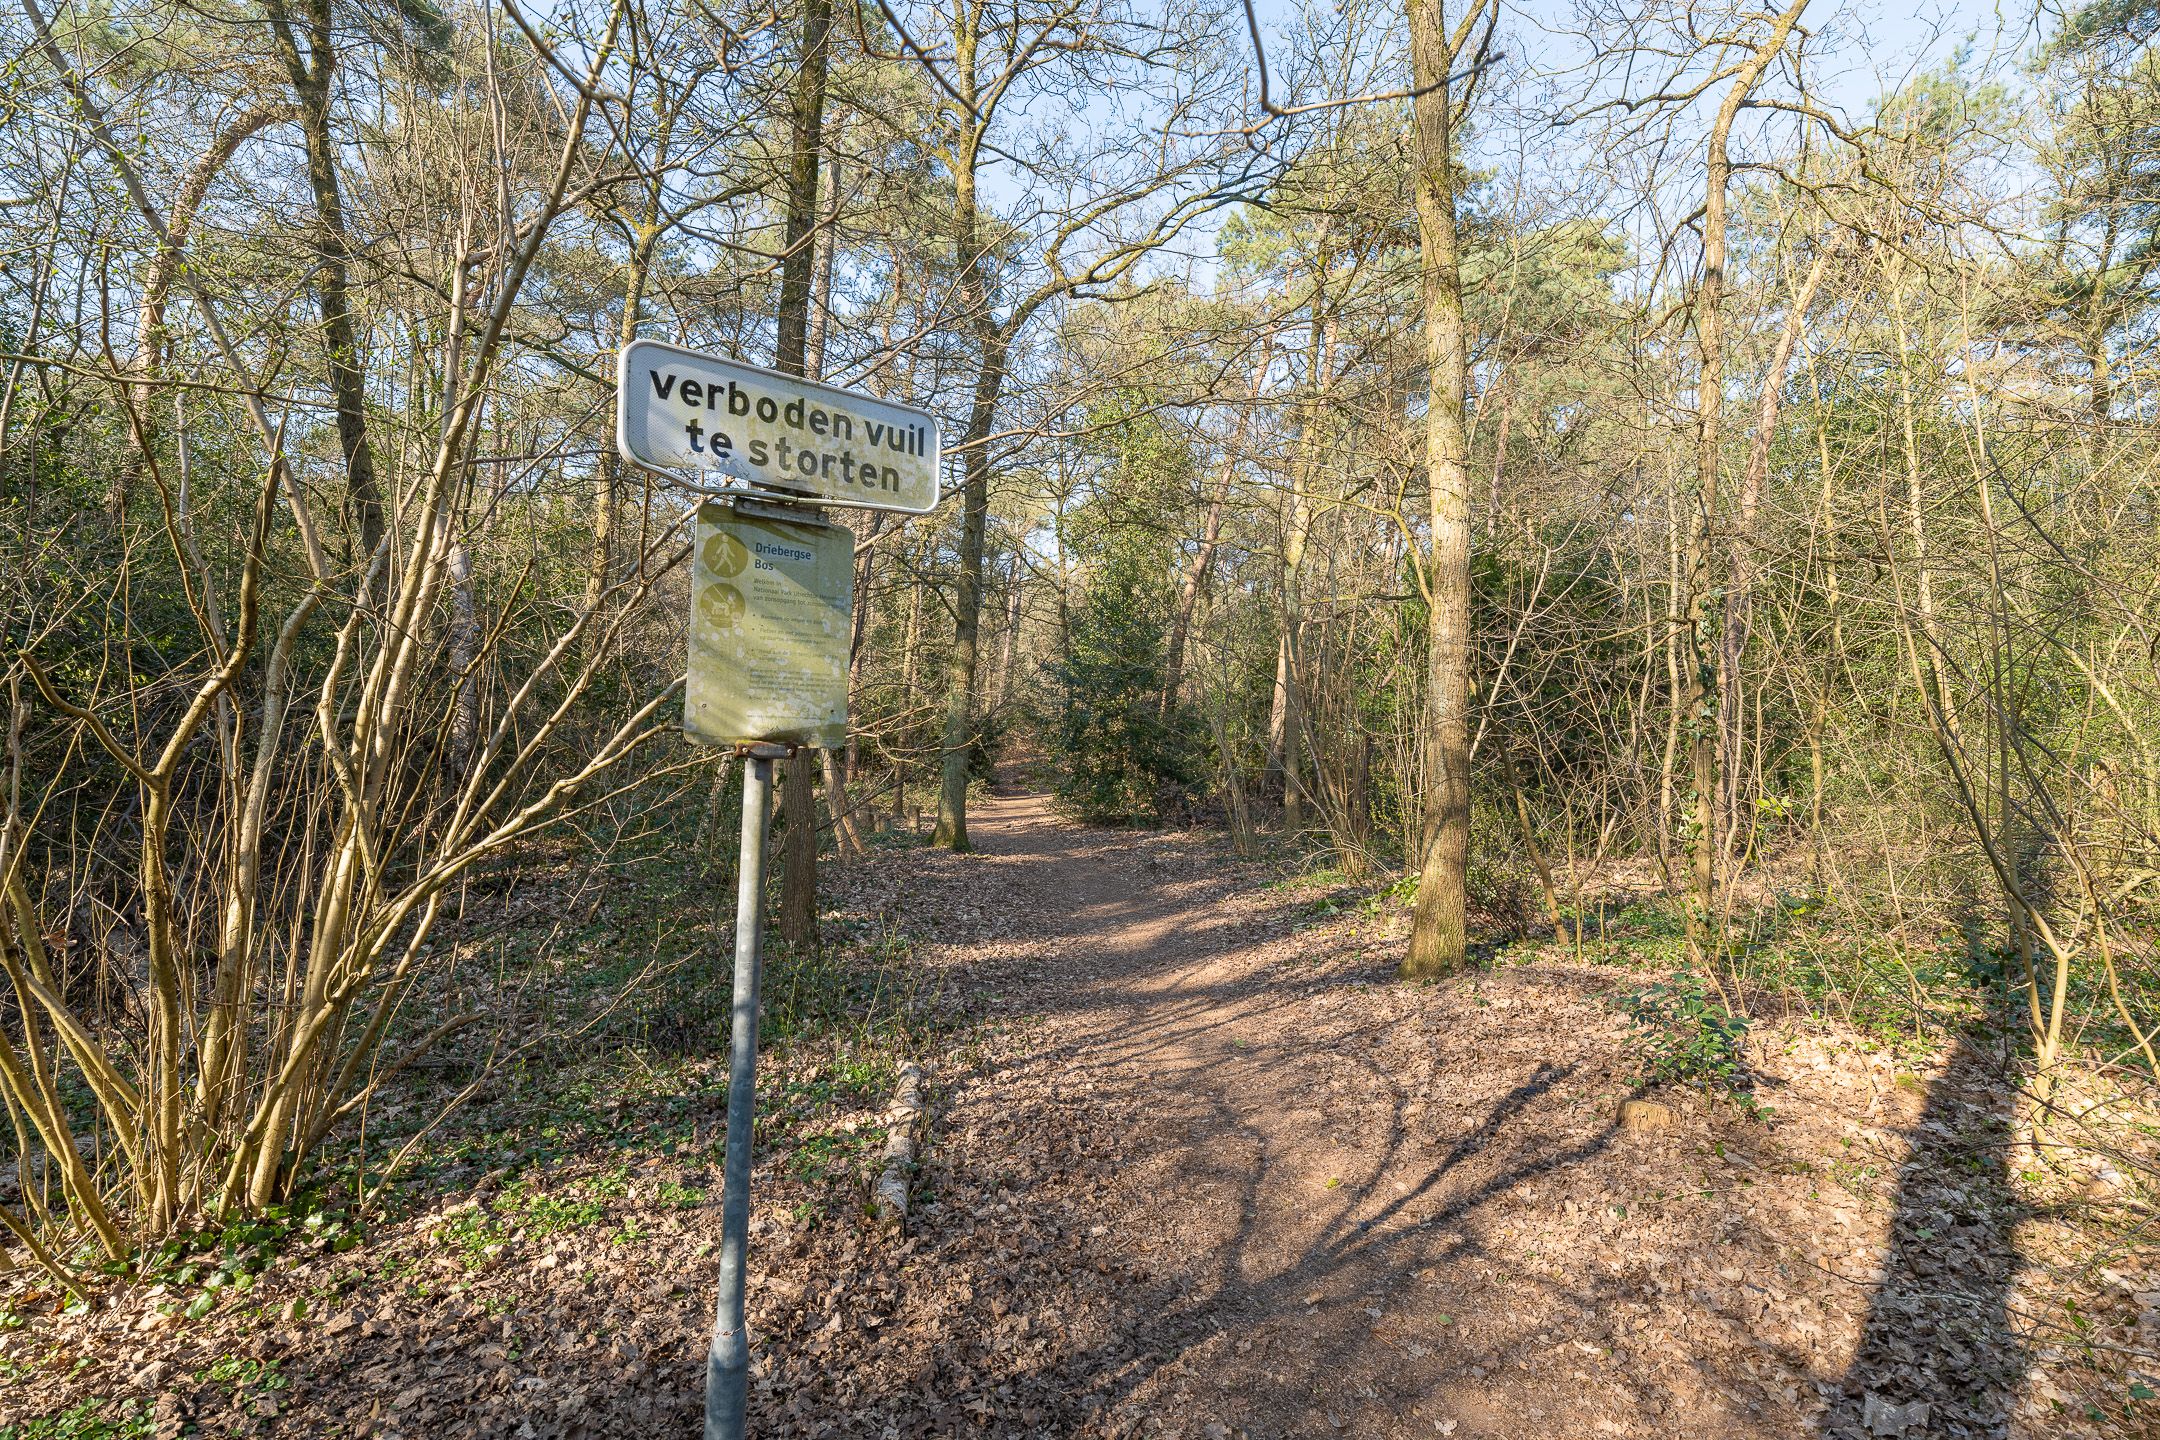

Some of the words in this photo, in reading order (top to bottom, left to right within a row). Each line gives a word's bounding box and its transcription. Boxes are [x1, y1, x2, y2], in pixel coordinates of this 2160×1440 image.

[649, 369, 852, 440] verboden
[864, 420, 925, 457] vuil
[685, 418, 733, 459] te
[748, 436, 900, 493] storten
[754, 559, 774, 571] Bos
[755, 543, 812, 560] Driebergse
